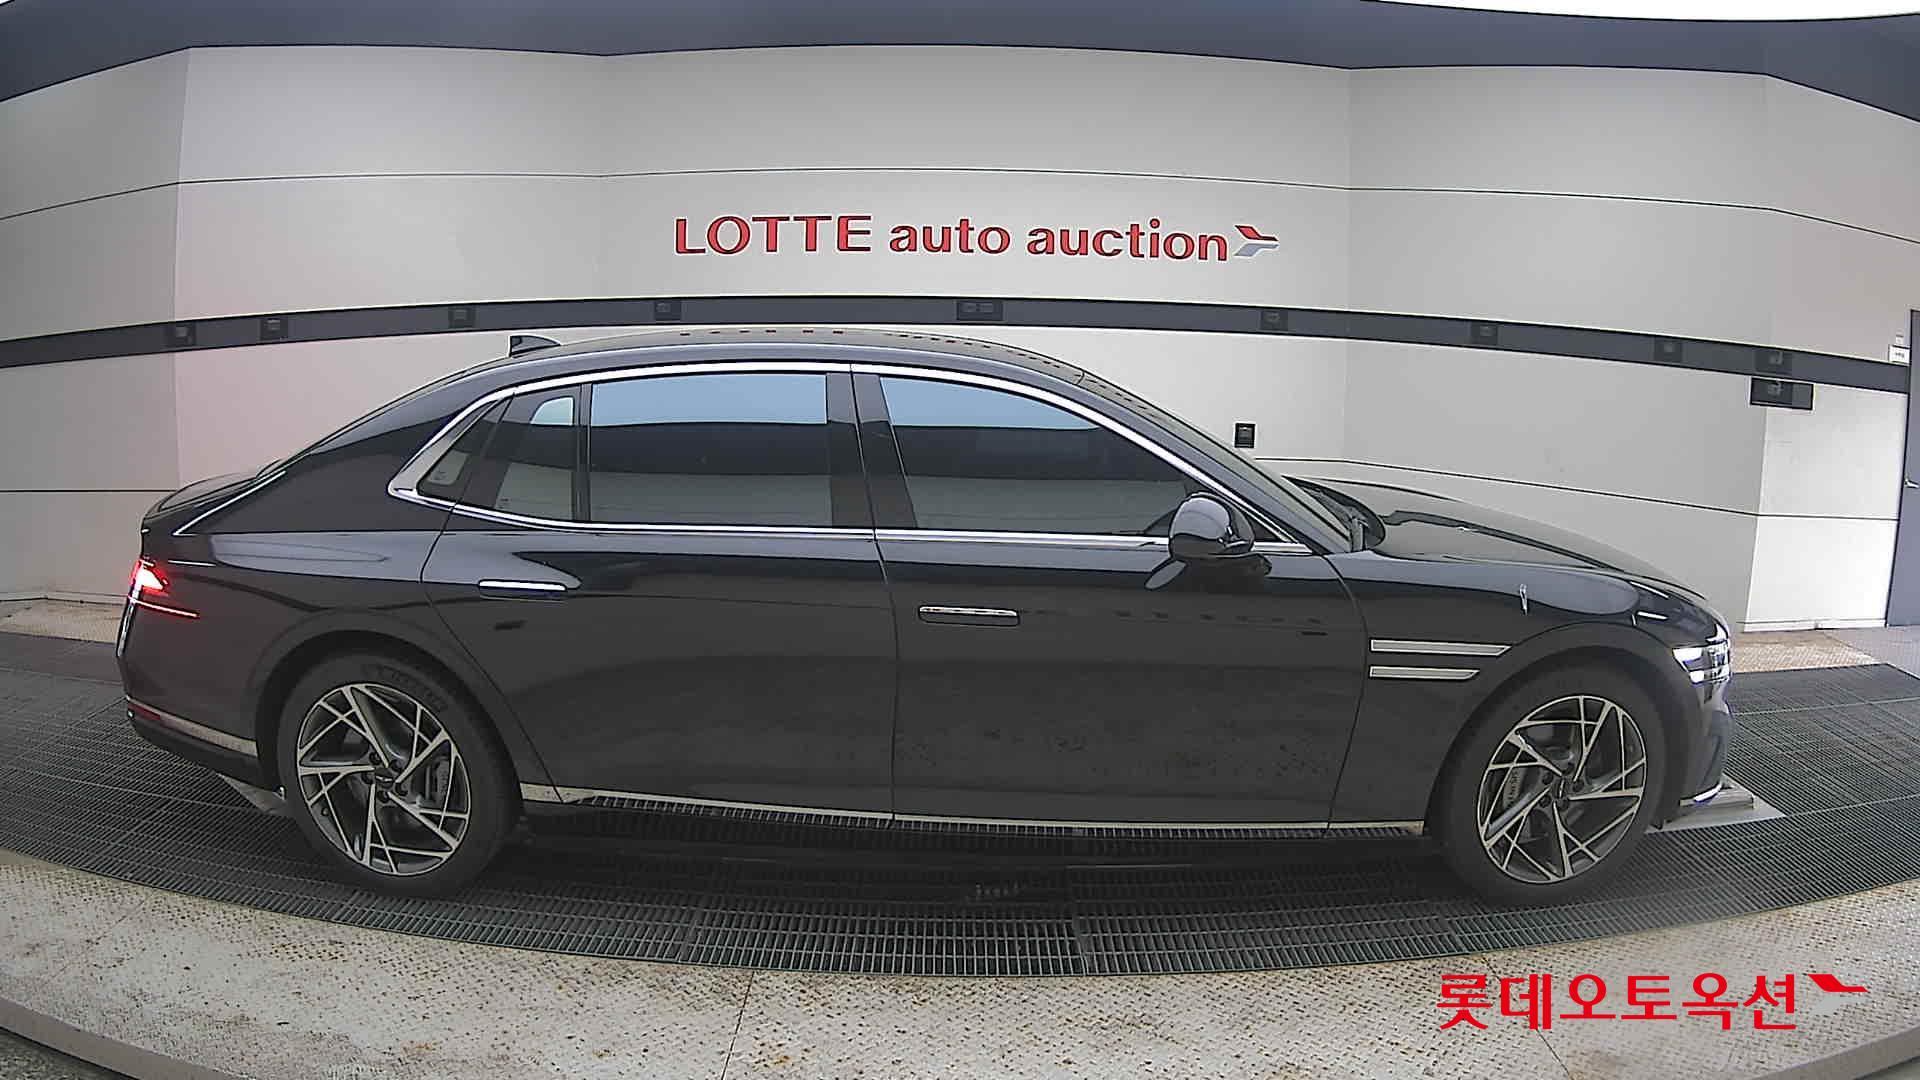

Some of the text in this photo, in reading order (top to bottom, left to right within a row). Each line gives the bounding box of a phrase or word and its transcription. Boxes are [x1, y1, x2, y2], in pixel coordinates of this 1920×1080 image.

[675, 215, 1228, 261] LOTTE auto auction
